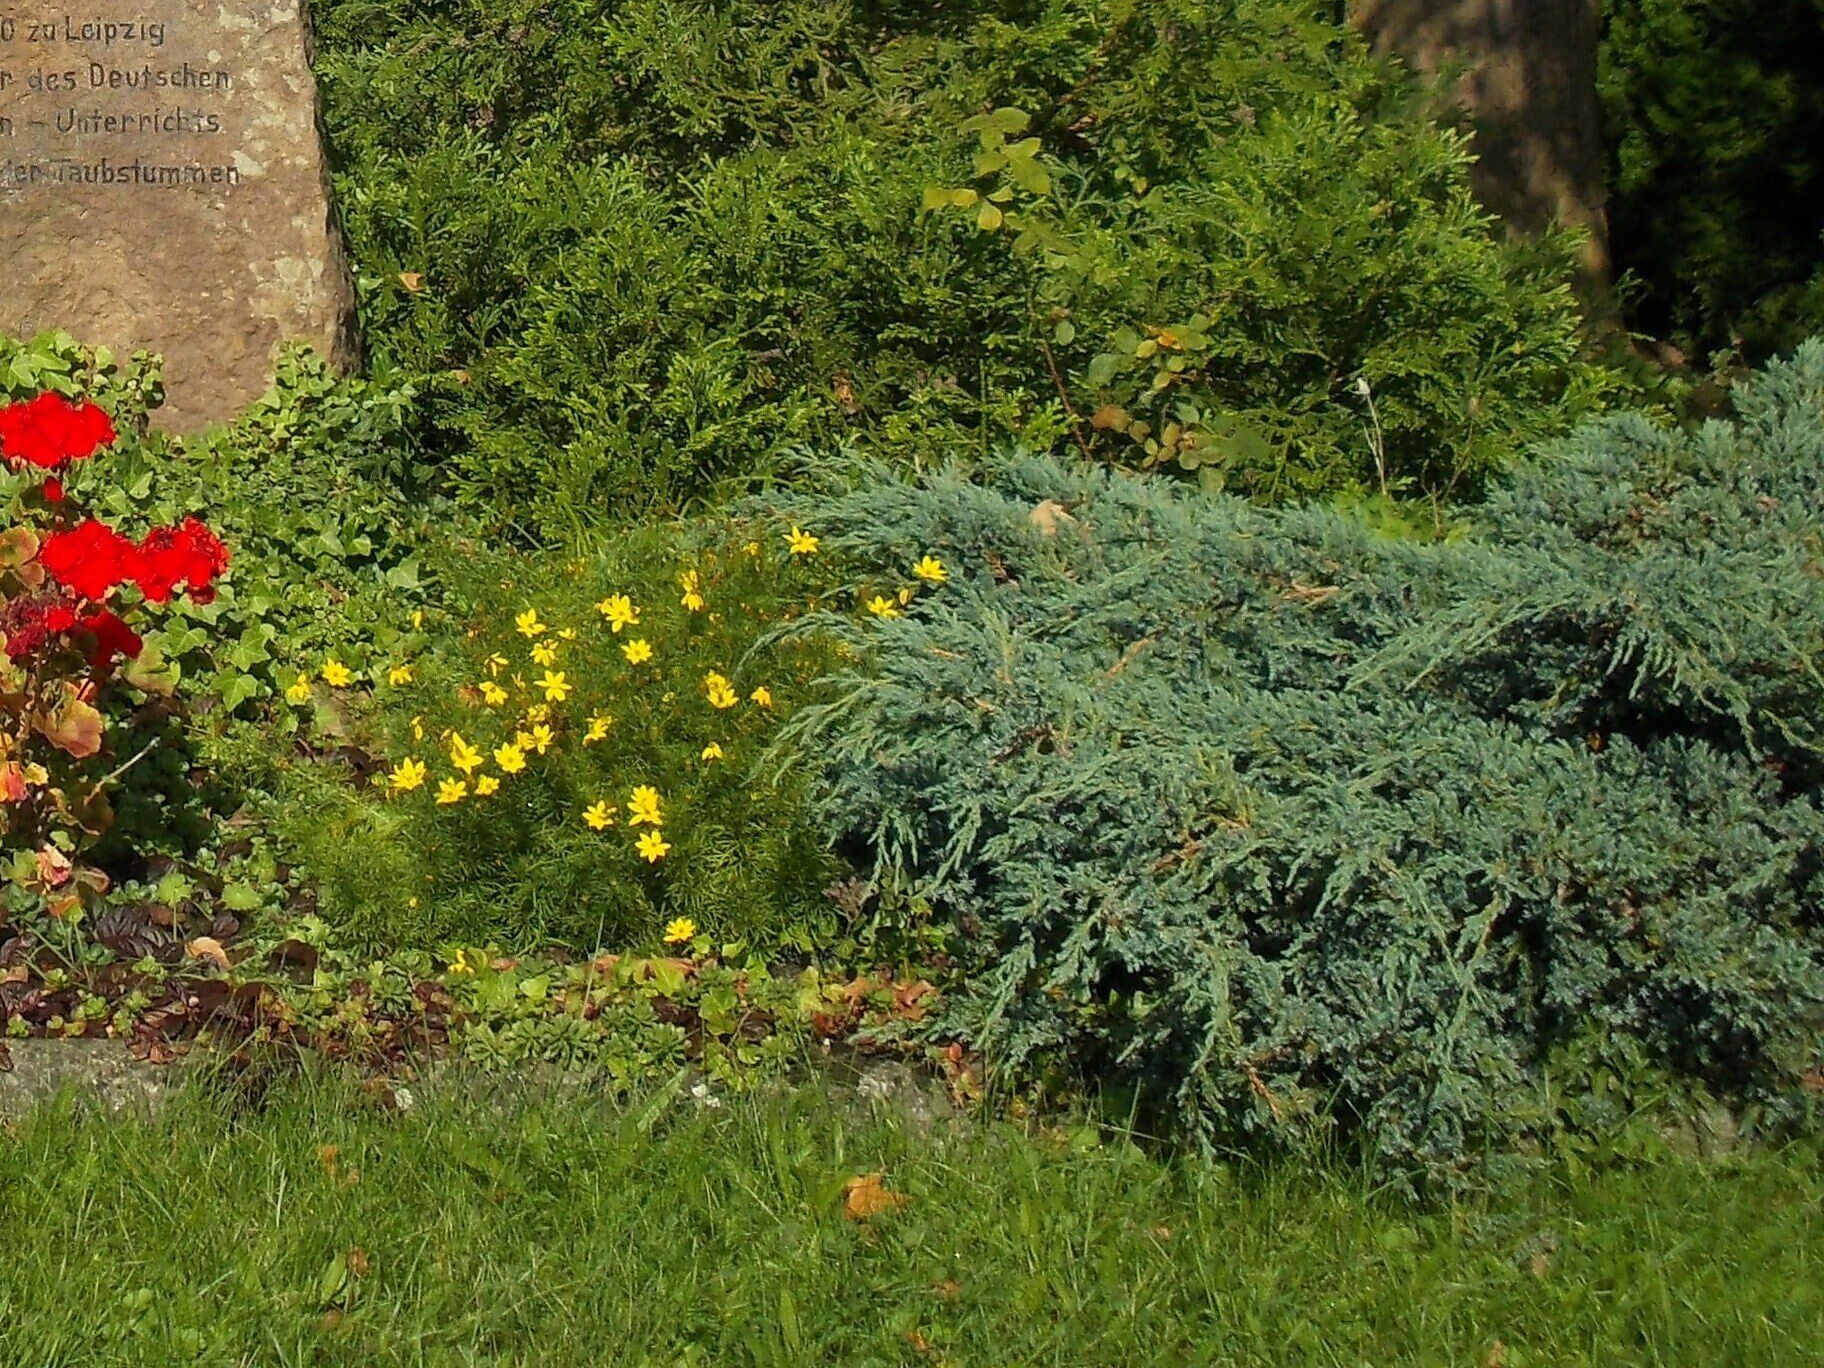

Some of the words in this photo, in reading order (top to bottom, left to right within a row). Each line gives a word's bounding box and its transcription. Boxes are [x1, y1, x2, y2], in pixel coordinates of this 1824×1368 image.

[27, 23, 56, 42] zu
[65, 15, 166, 47] Leipzig
[28, 67, 77, 91] des
[89, 62, 231, 90] Deutschen
[56, 106, 221, 134] Unterrichts
[51, 157, 241, 185] Taubstummen
